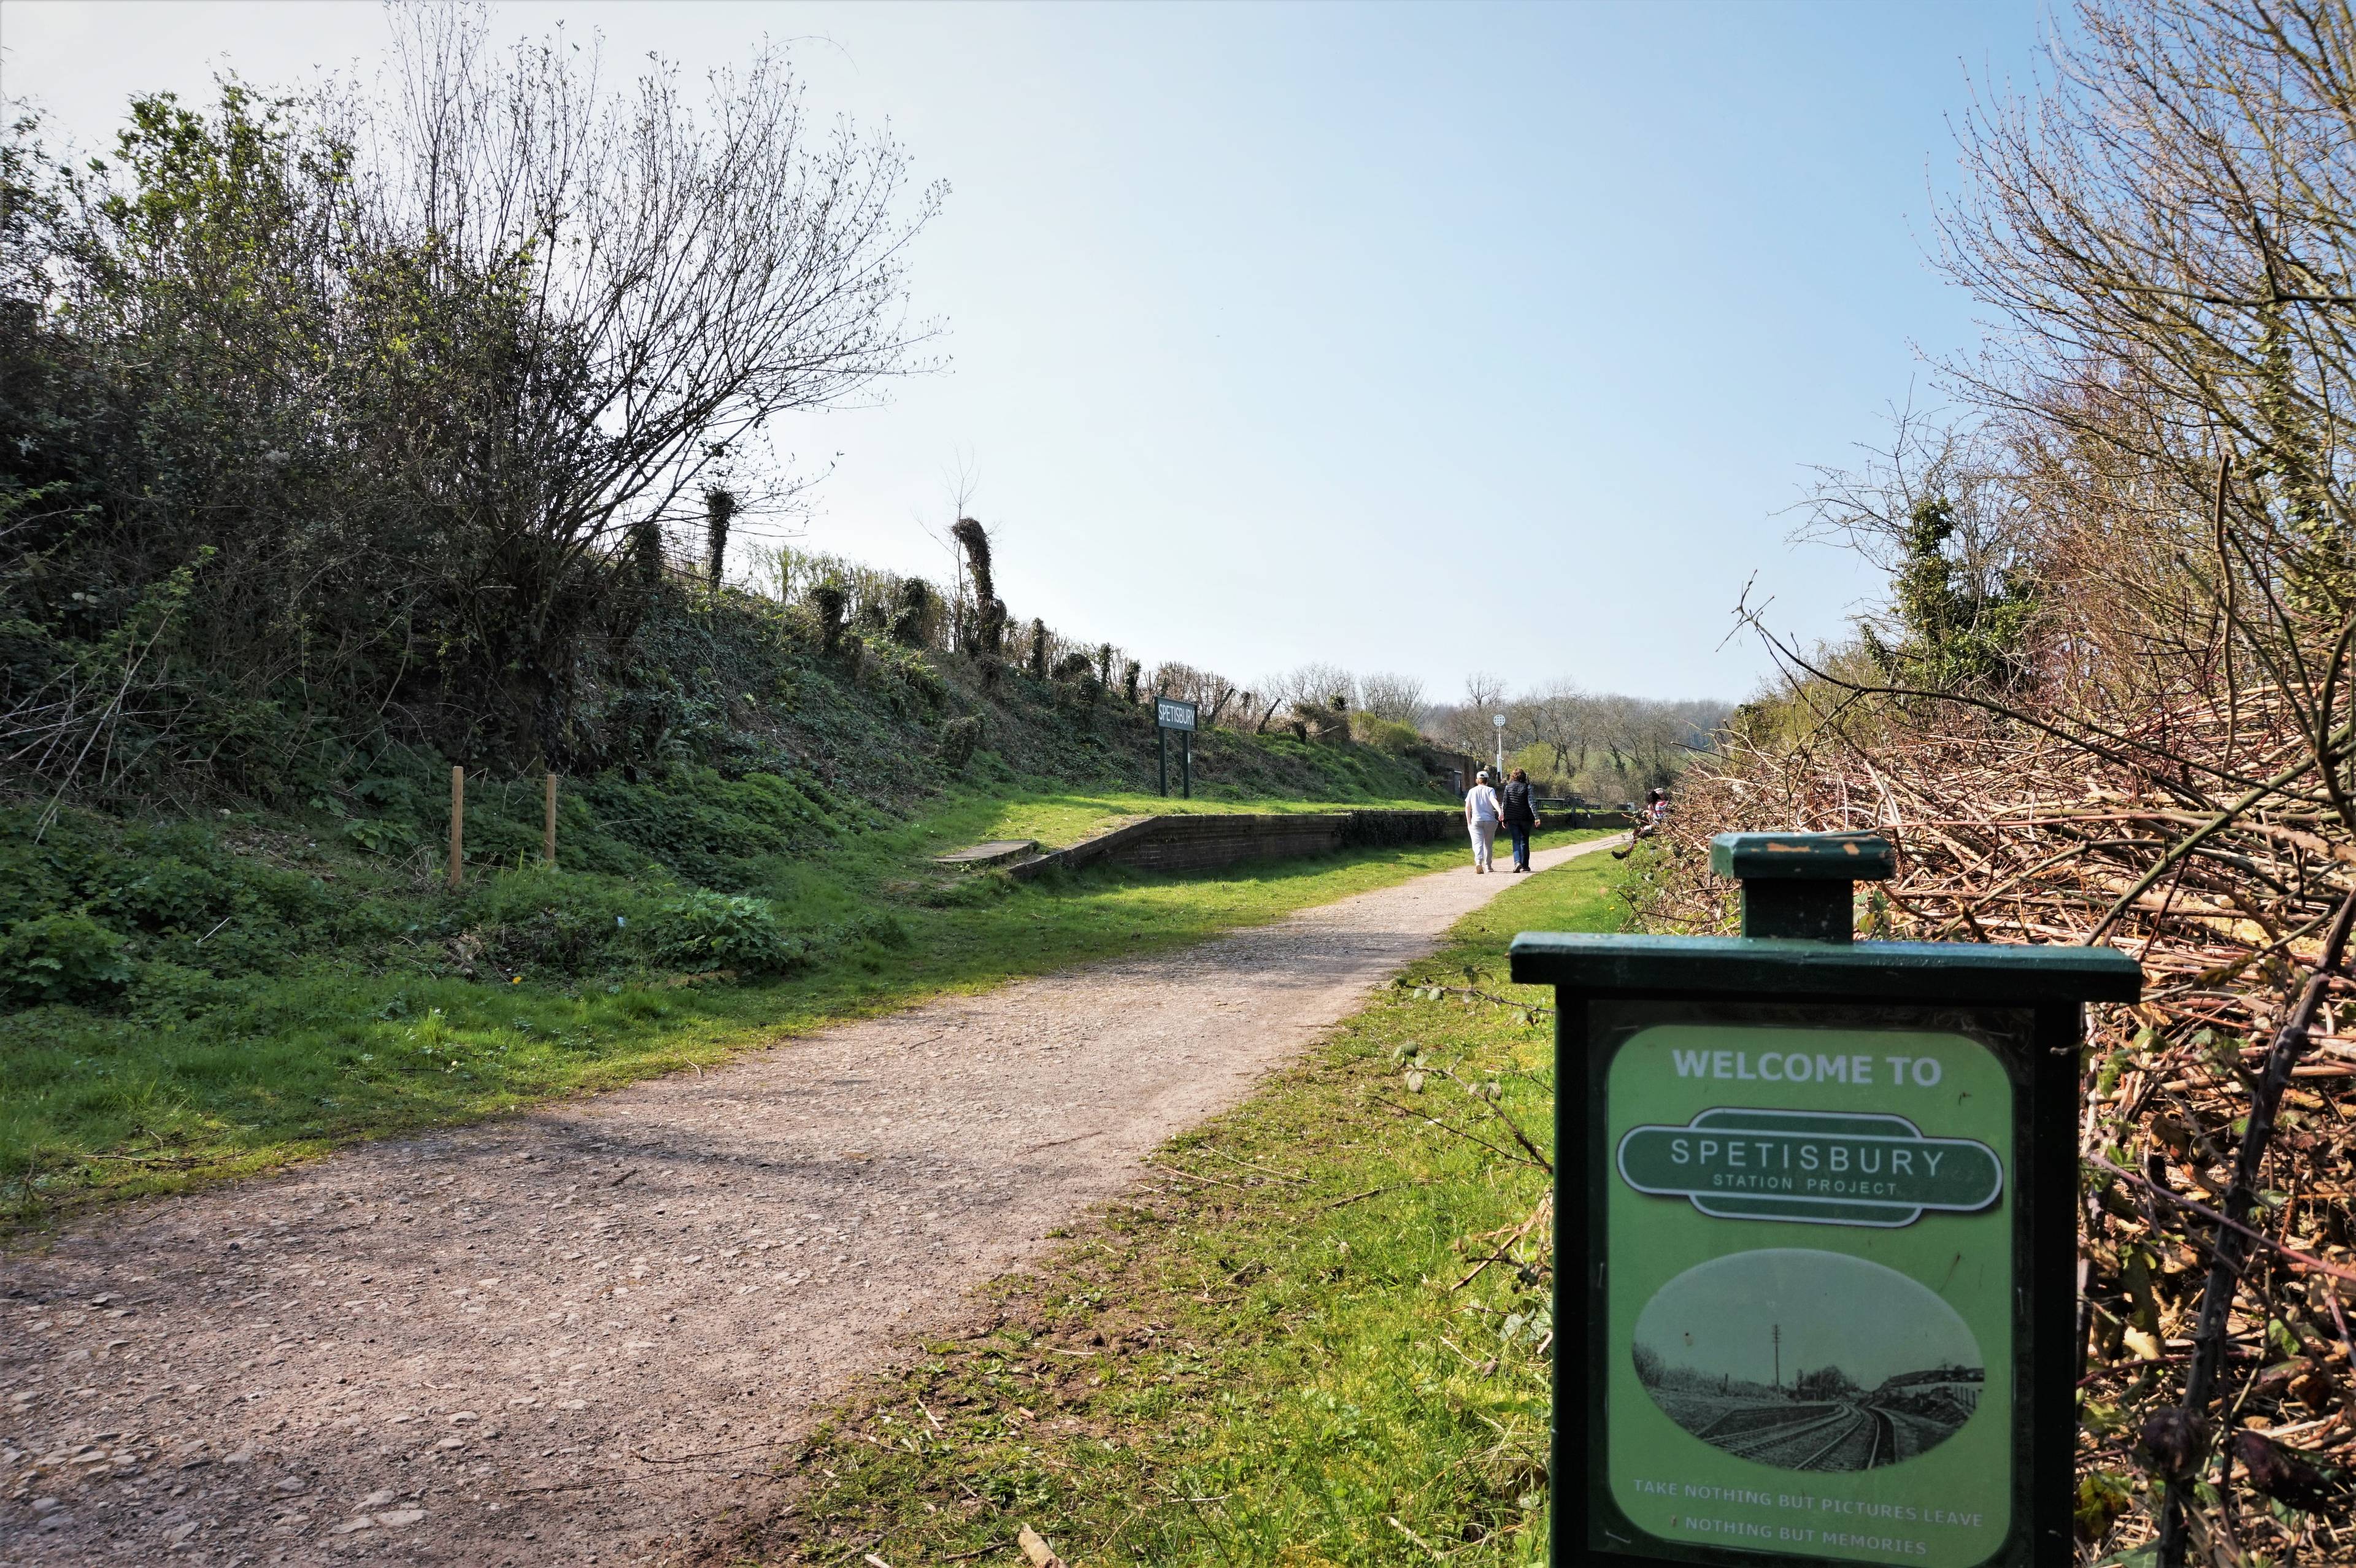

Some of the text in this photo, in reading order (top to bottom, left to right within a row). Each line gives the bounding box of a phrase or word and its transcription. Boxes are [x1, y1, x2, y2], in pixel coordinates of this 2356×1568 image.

[1158, 704, 1195, 725] SPETISBURY
[1673, 1049, 1941, 1086] WELCOME TO
[1671, 1139, 1943, 1176] SPETISBURY
[1713, 1174, 1897, 1195] STATION PROJECT
[1634, 1479, 1983, 1527] TAKE NOTHING BUT PICTURES LEAVE
[1685, 1517, 1927, 1555] NOTHING BUT MEMORIES
